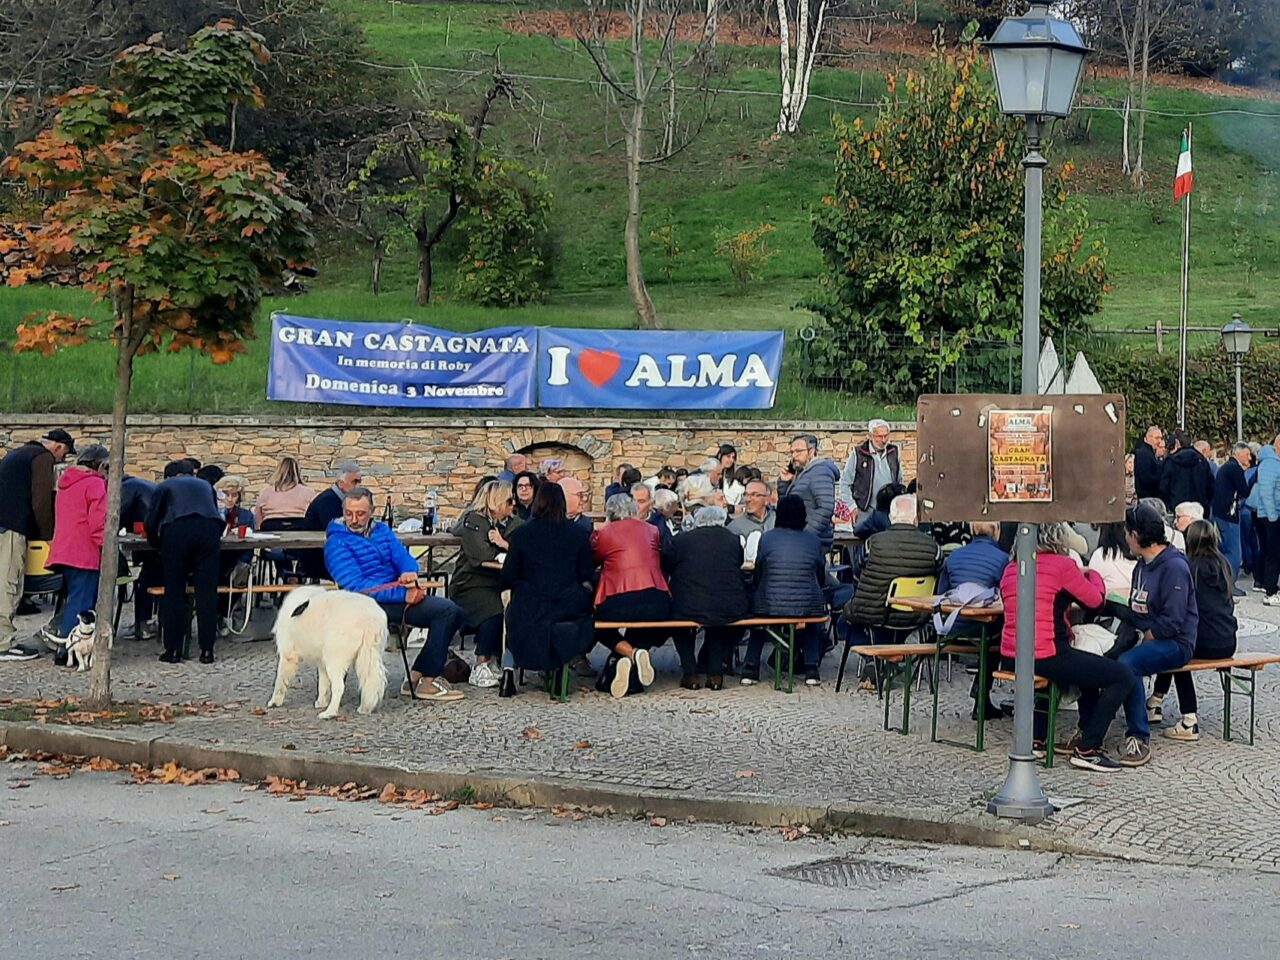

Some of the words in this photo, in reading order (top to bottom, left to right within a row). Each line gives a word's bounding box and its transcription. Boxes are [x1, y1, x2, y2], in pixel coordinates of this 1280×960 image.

[278, 326, 355, 348] GRAN
[363, 333, 530, 354] CASTAGNATA
[337, 354, 353, 366] In
[355, 358, 418, 370] memoria
[420, 358, 436, 370] di
[438, 360, 473, 373] Roby
[547, 346, 571, 386] I
[624, 353, 774, 388] ALMA
[304, 373, 399, 395] Domenica
[406, 386, 418, 398] 3
[423, 384, 504, 398] Novembre
